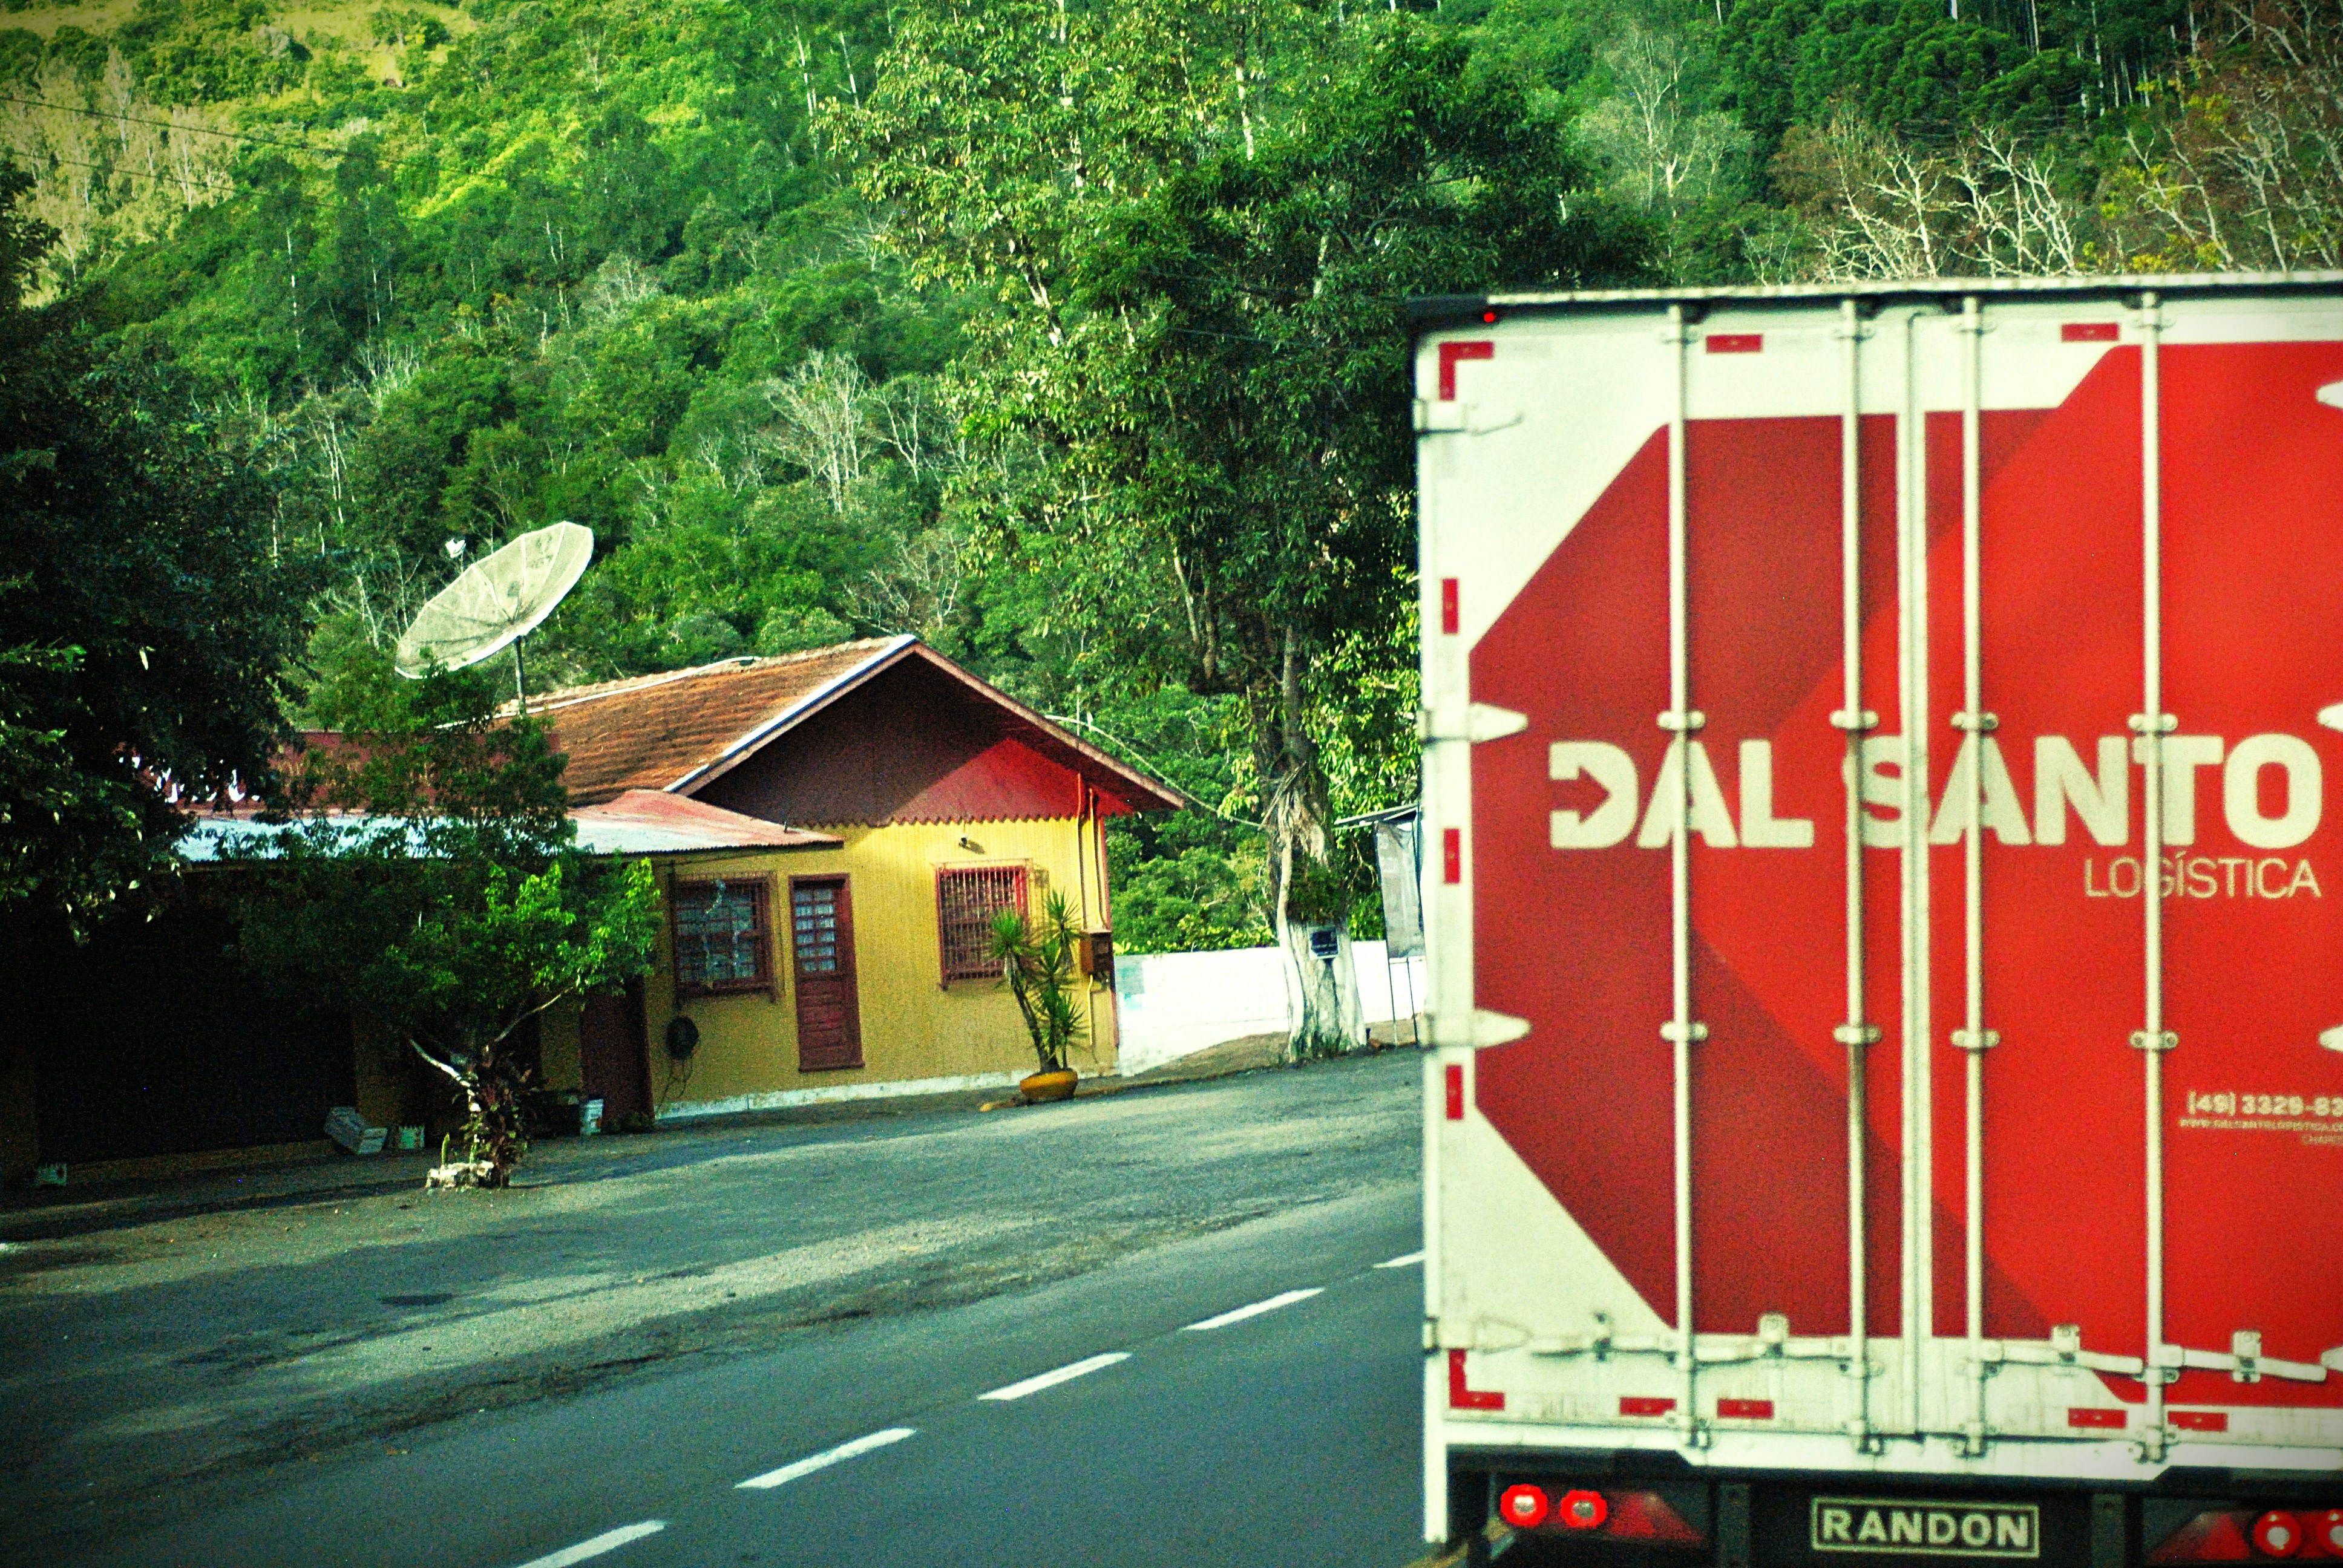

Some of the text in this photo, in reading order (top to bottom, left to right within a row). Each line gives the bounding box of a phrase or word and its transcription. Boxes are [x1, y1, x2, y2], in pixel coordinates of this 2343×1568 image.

[1548, 733, 2323, 849] DAL SANTO
[2085, 850, 2322, 899] LOGÍSTICA
[1822, 1509, 2029, 1548] RANDON
